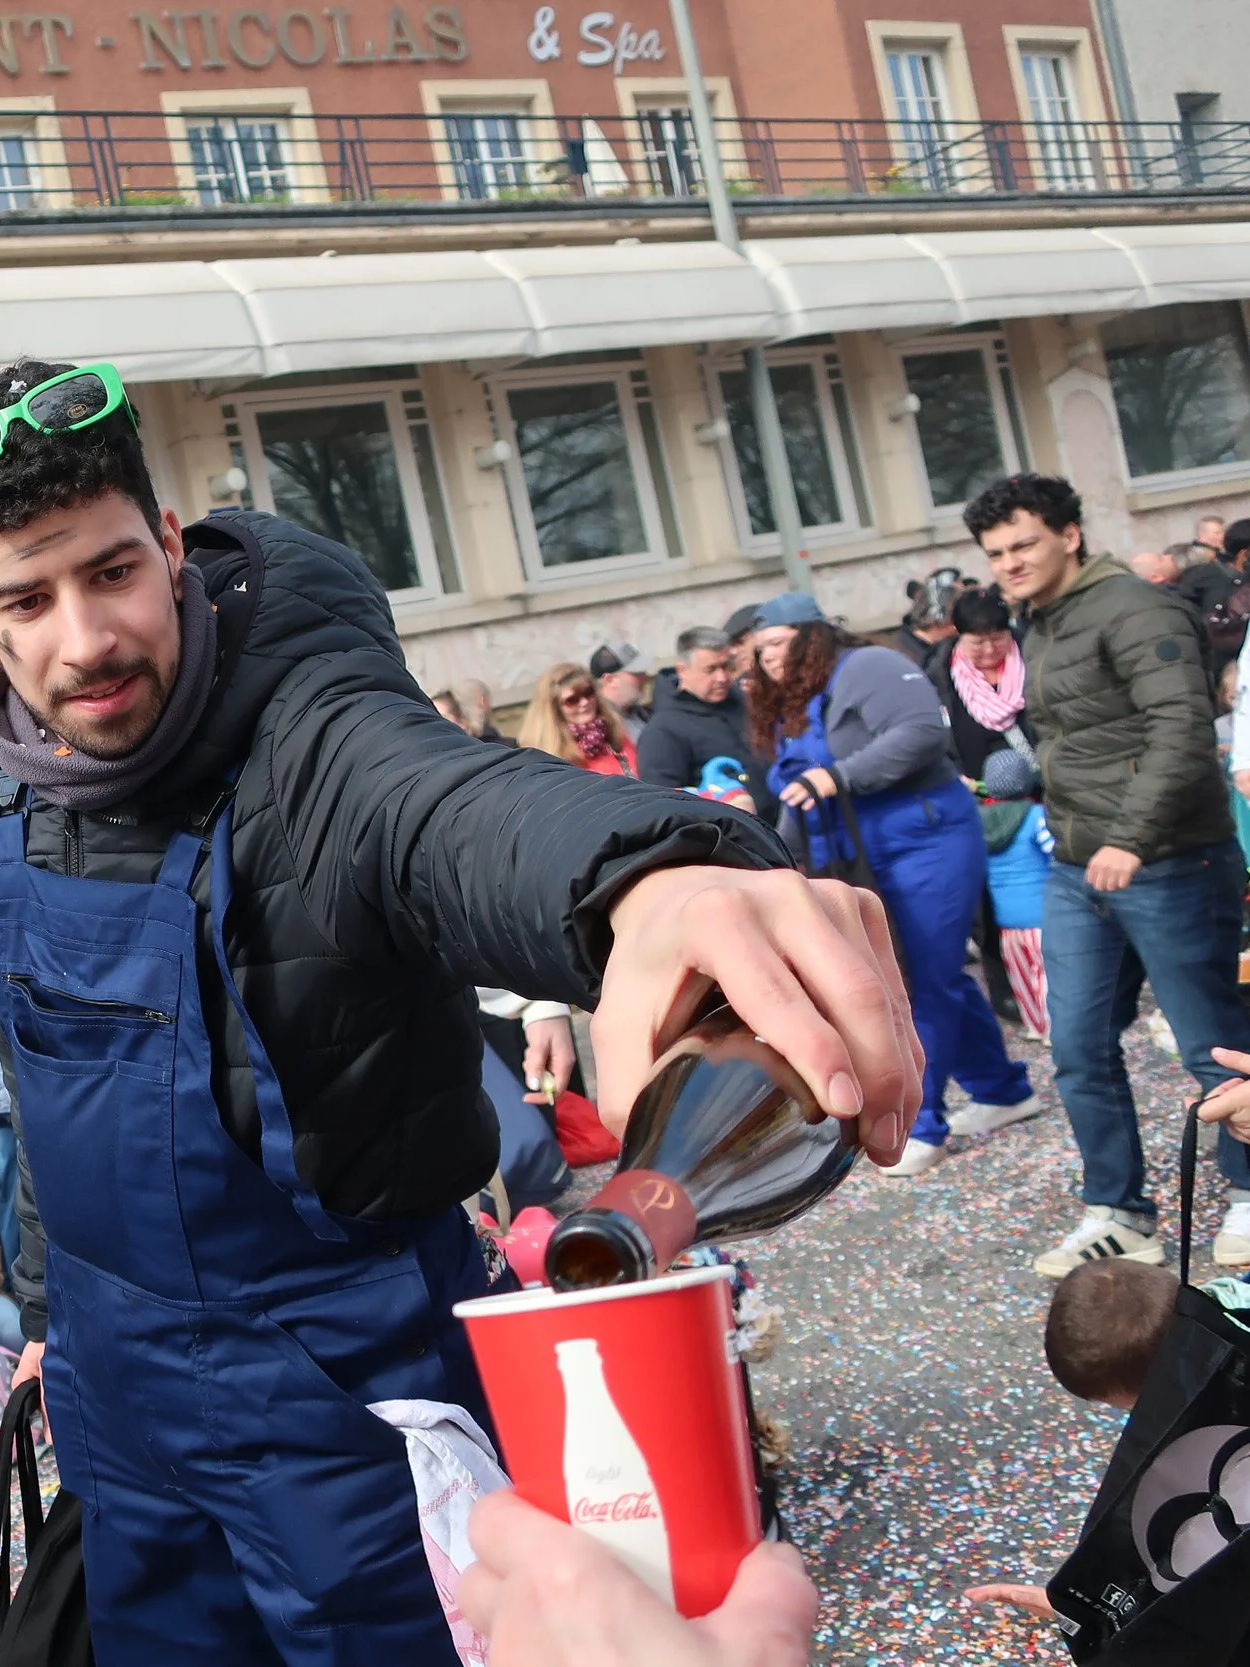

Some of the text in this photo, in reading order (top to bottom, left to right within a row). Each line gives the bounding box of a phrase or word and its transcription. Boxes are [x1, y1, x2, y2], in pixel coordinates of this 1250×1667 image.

[130, 5, 470, 71] NICOLAS
[527, 6, 666, 76] & Spa
